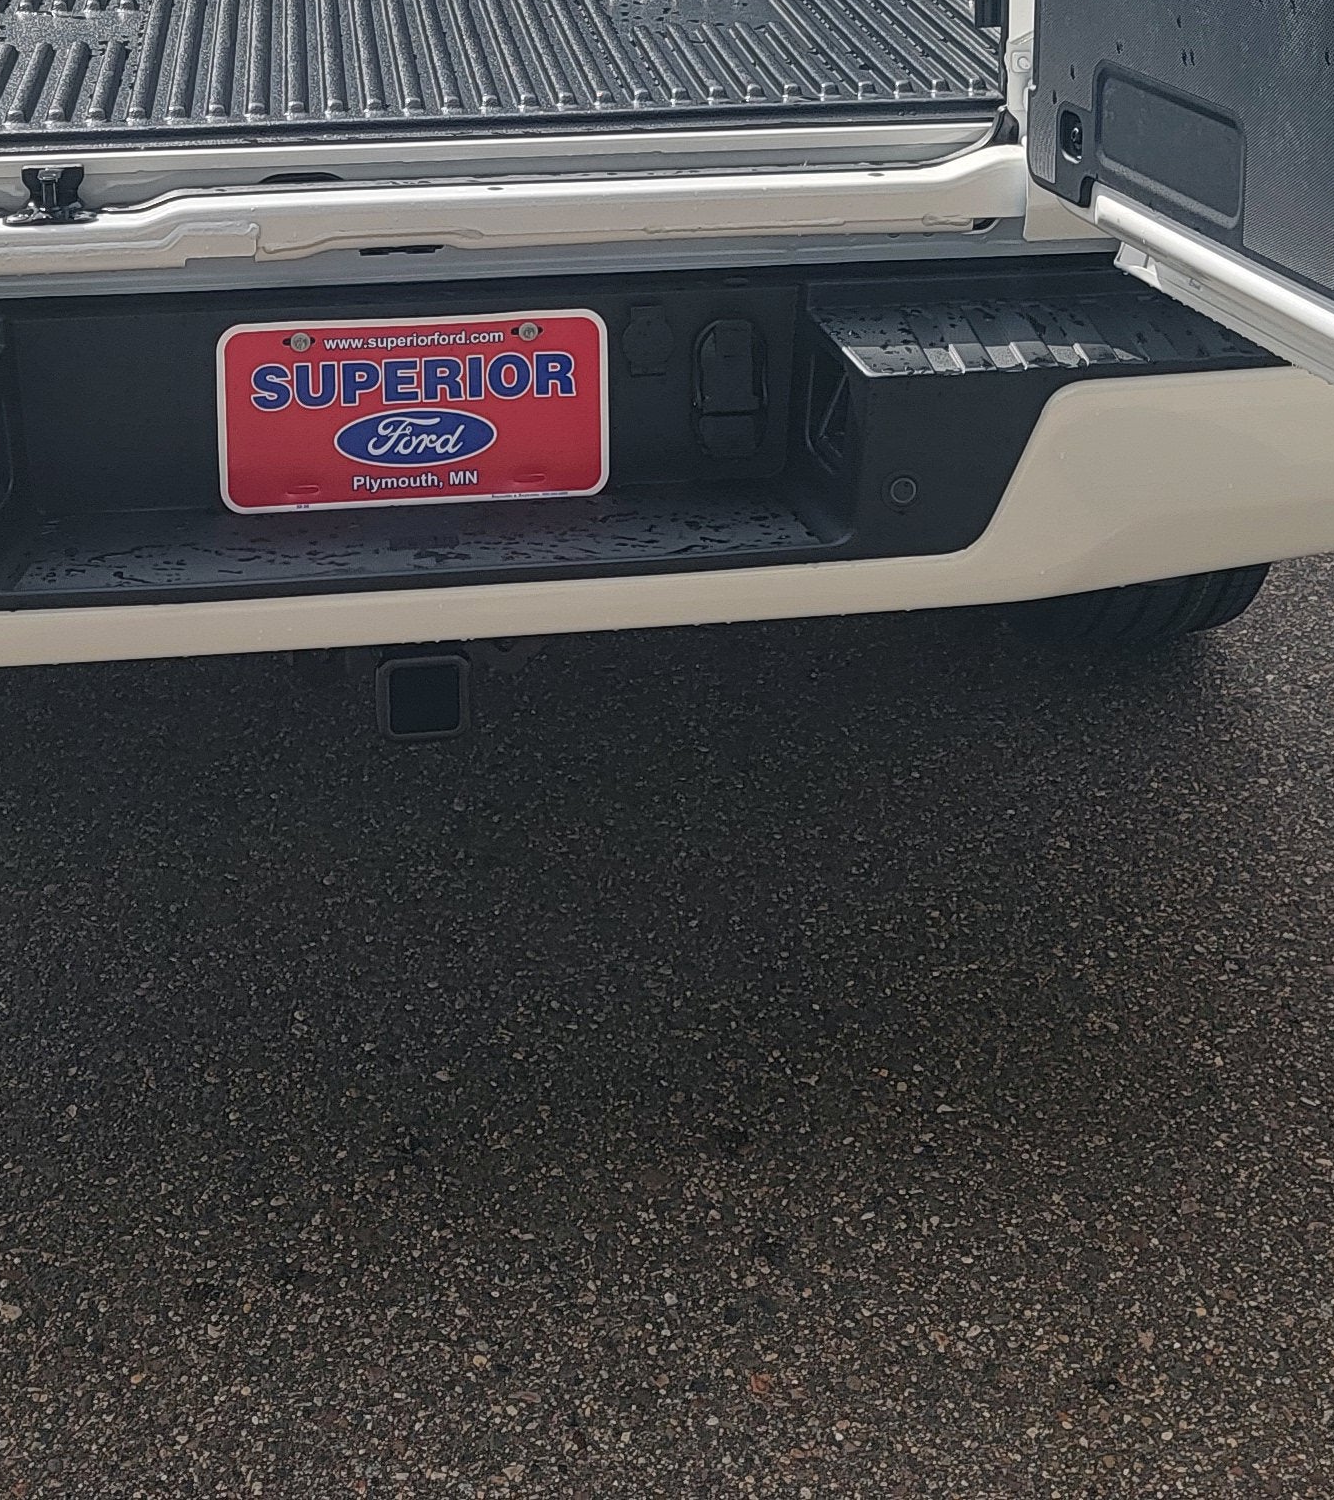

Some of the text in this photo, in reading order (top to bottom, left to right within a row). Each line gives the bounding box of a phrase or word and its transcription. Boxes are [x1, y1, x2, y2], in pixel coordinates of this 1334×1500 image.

[323, 329, 504, 350] www.superiorford.com
[251, 351, 576, 411] SUPERIOR
[367, 416, 465, 456] Ford
[353, 470, 478, 493] Plymouth, MN
